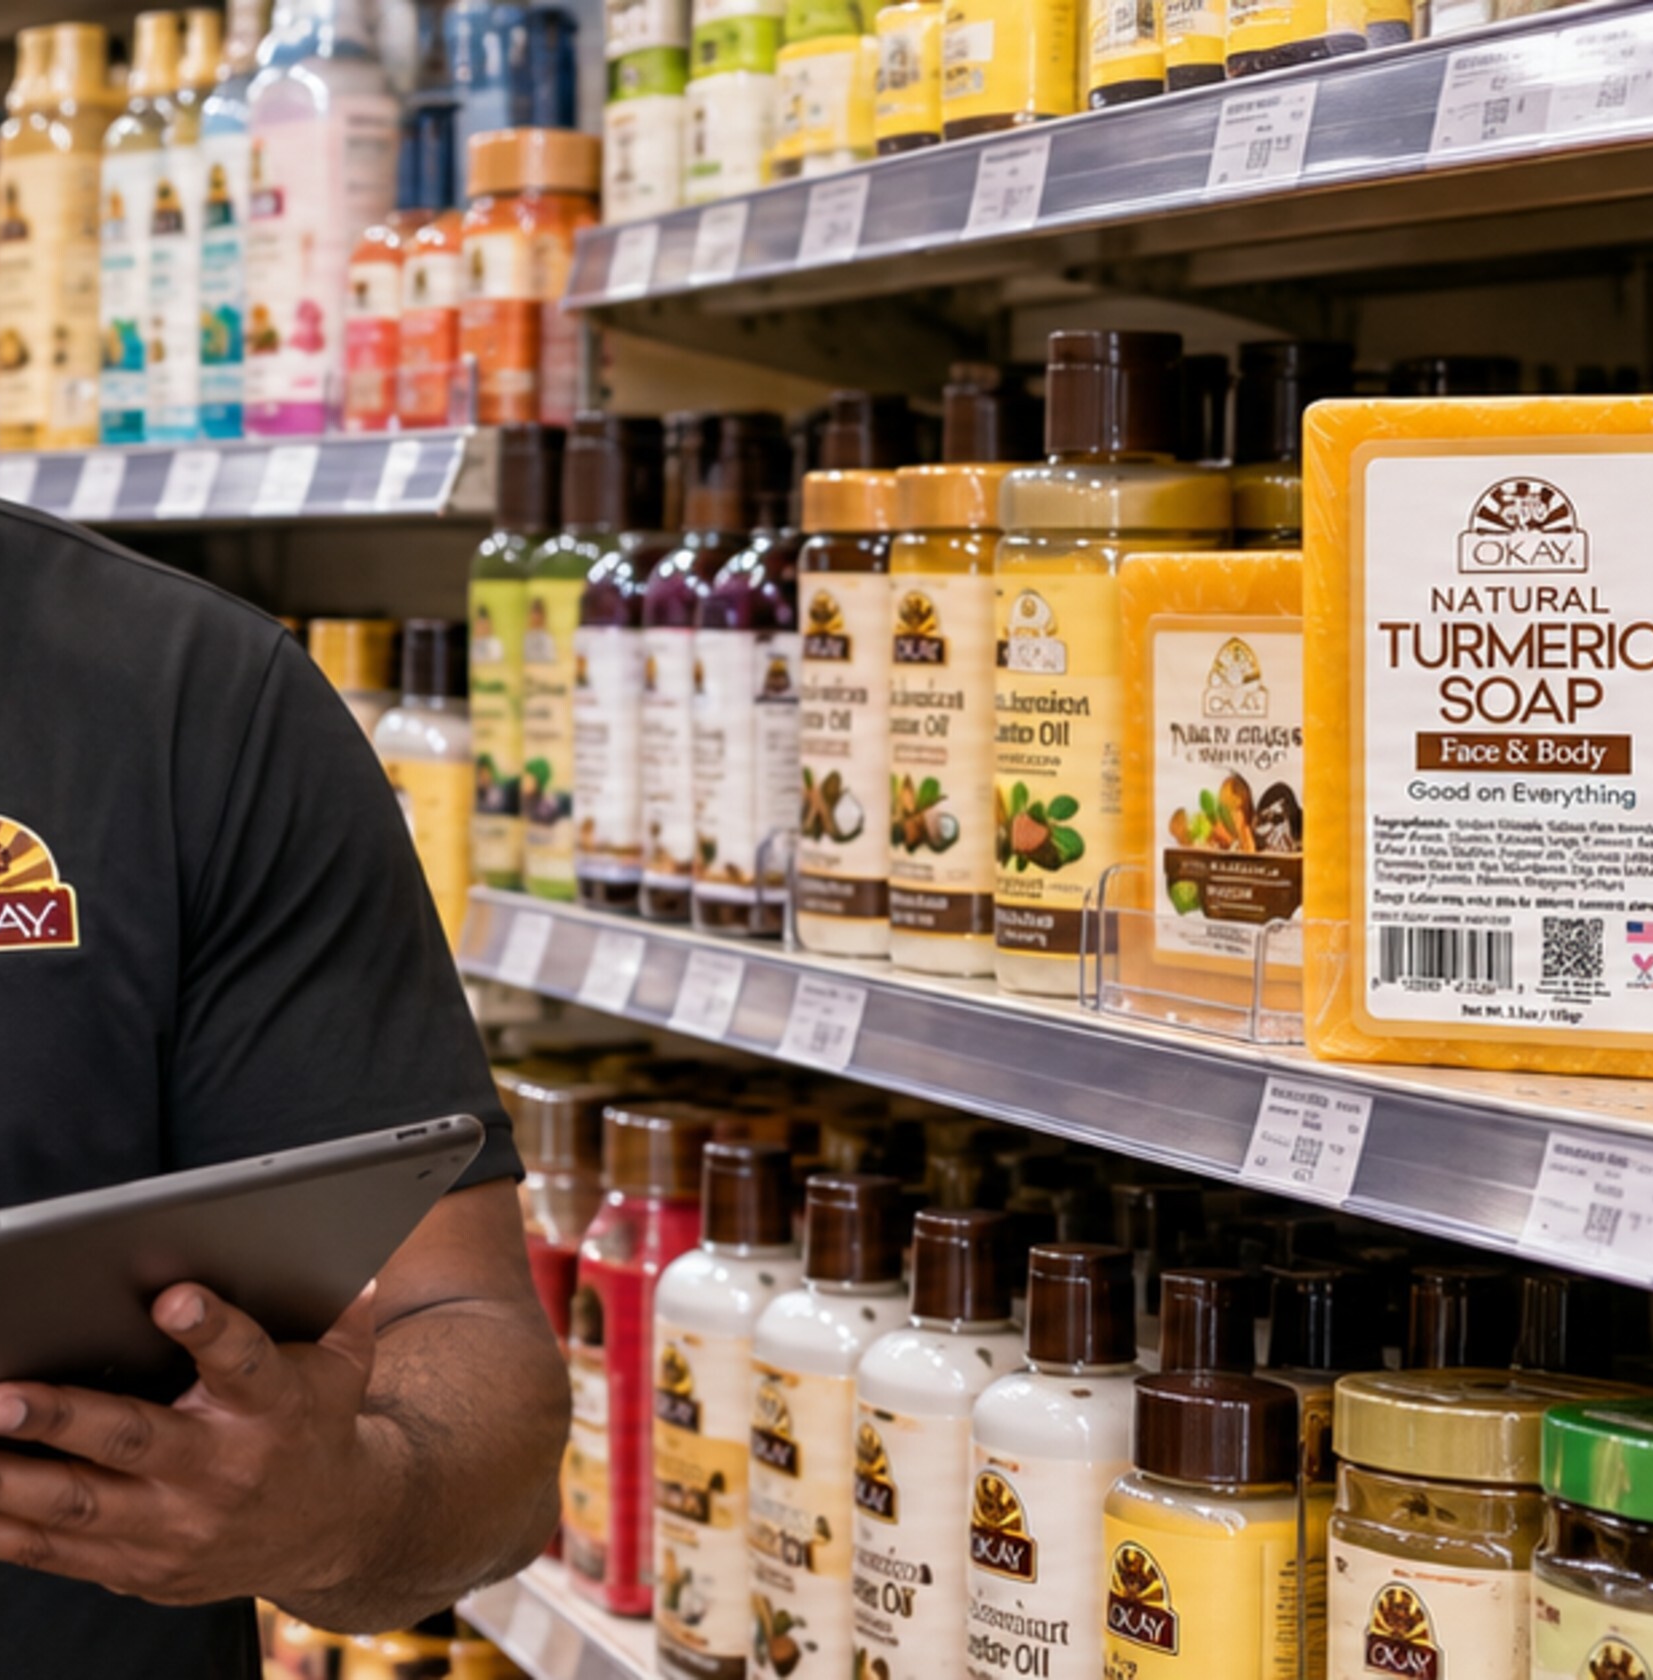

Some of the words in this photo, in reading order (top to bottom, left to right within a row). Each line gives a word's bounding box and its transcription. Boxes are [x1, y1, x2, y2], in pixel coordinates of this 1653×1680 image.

[1431, 586, 1611, 614] NATURAL
[1439, 676, 1604, 725] SOAP
[1440, 737, 1500, 764] Face
[1506, 739, 1529, 764] &
[1536, 739, 1607, 771] Body
[1407, 780, 1470, 801] Good
[1477, 785, 1505, 802] on
[1513, 783, 1637, 810] Everything
